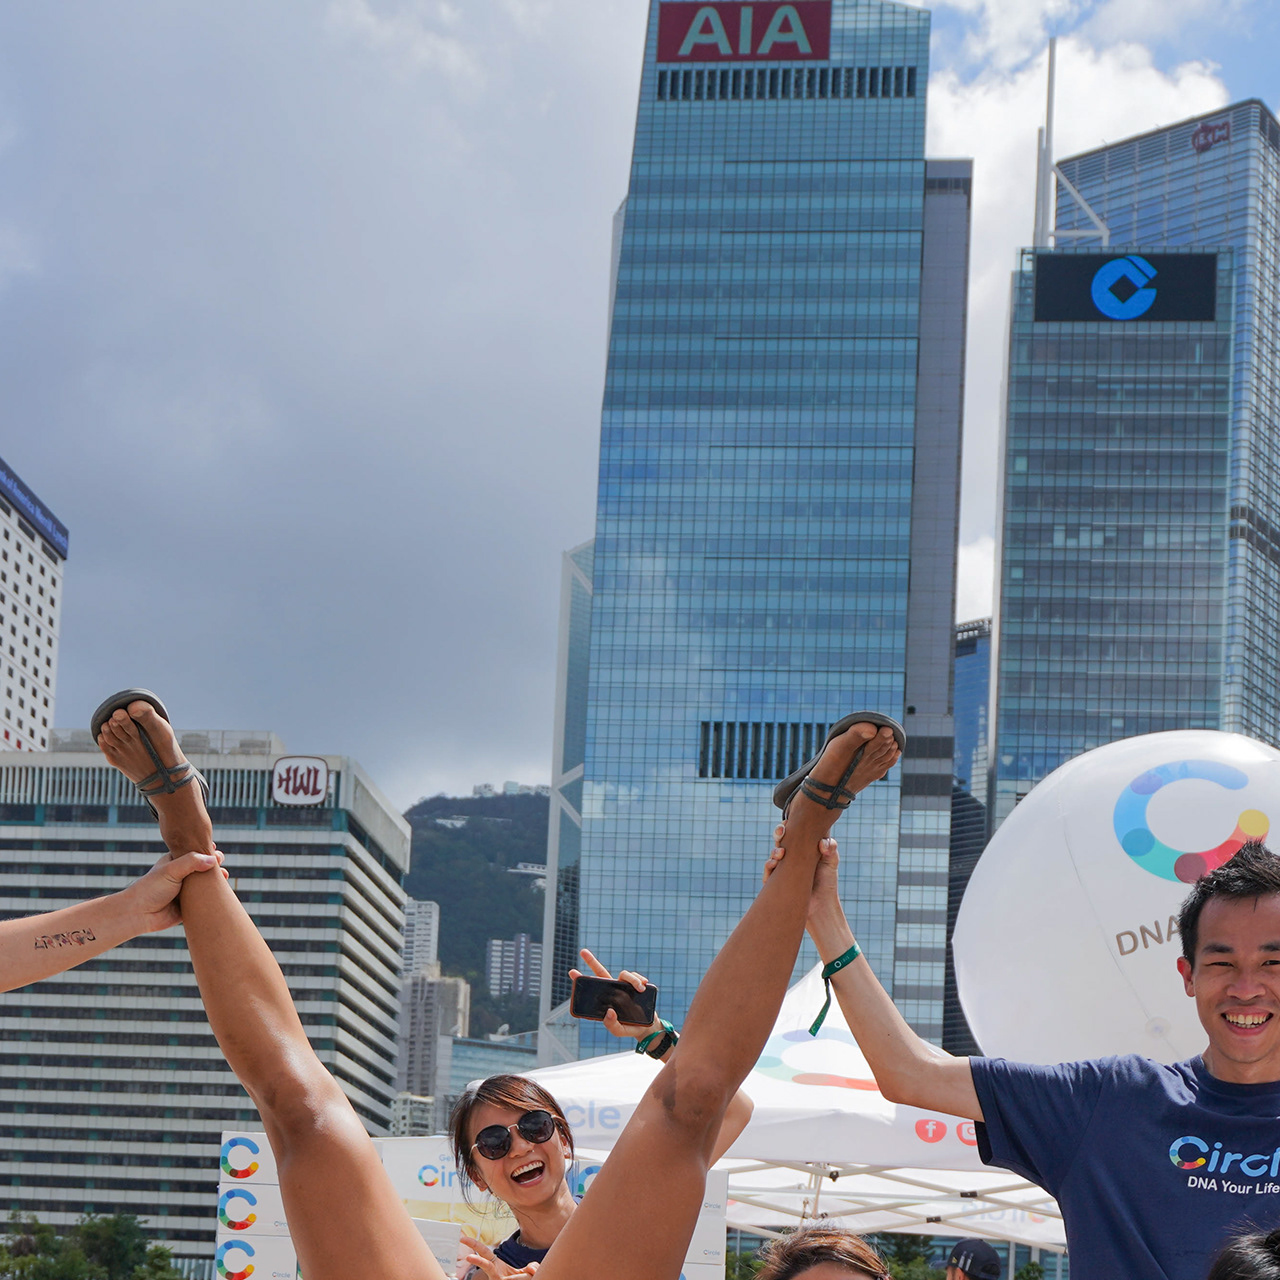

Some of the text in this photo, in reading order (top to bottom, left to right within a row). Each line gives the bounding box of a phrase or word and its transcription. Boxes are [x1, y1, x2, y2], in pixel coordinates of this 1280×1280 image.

[678, 5, 812, 56] AIA
[277, 765, 322, 796] HWL
[418, 1164, 461, 1188] Cir
[1187, 1175, 1280, 1194] DNA Your Life
